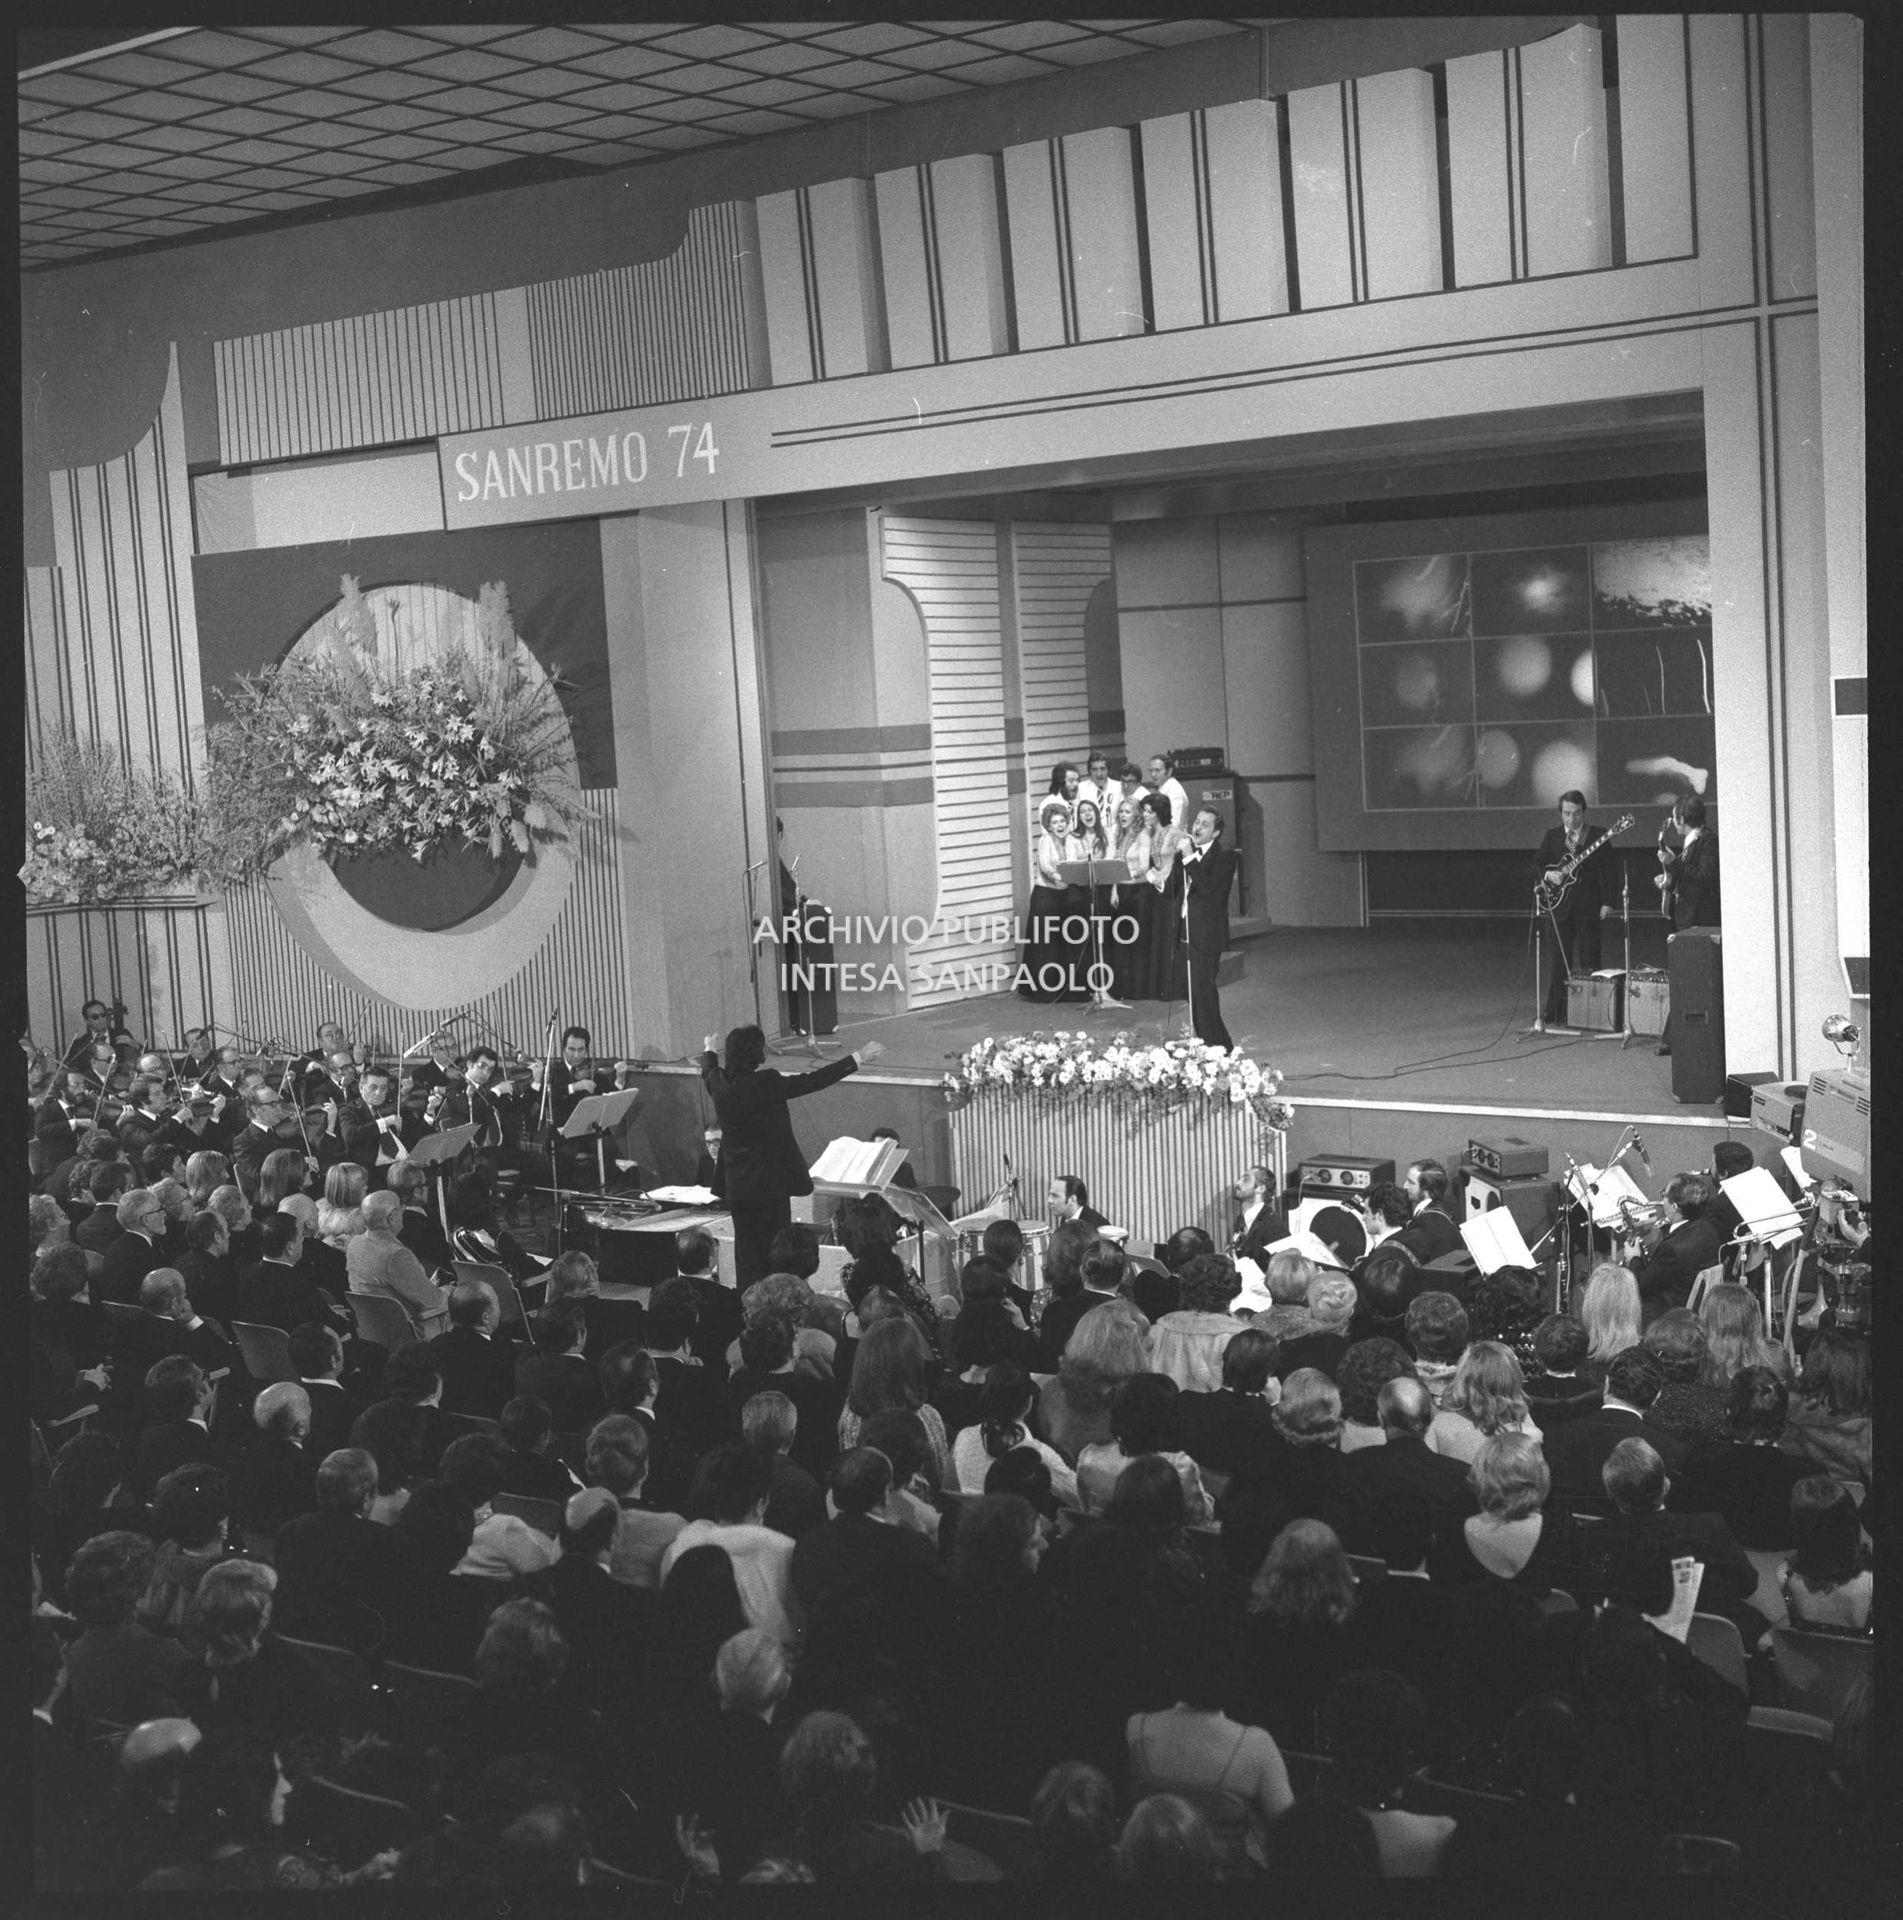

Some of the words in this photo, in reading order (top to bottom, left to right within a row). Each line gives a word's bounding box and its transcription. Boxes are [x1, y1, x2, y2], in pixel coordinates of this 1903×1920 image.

[455, 432, 648, 502] SANREMO
[667, 421, 720, 478] 74
[1803, 1128, 1817, 1152] 2
